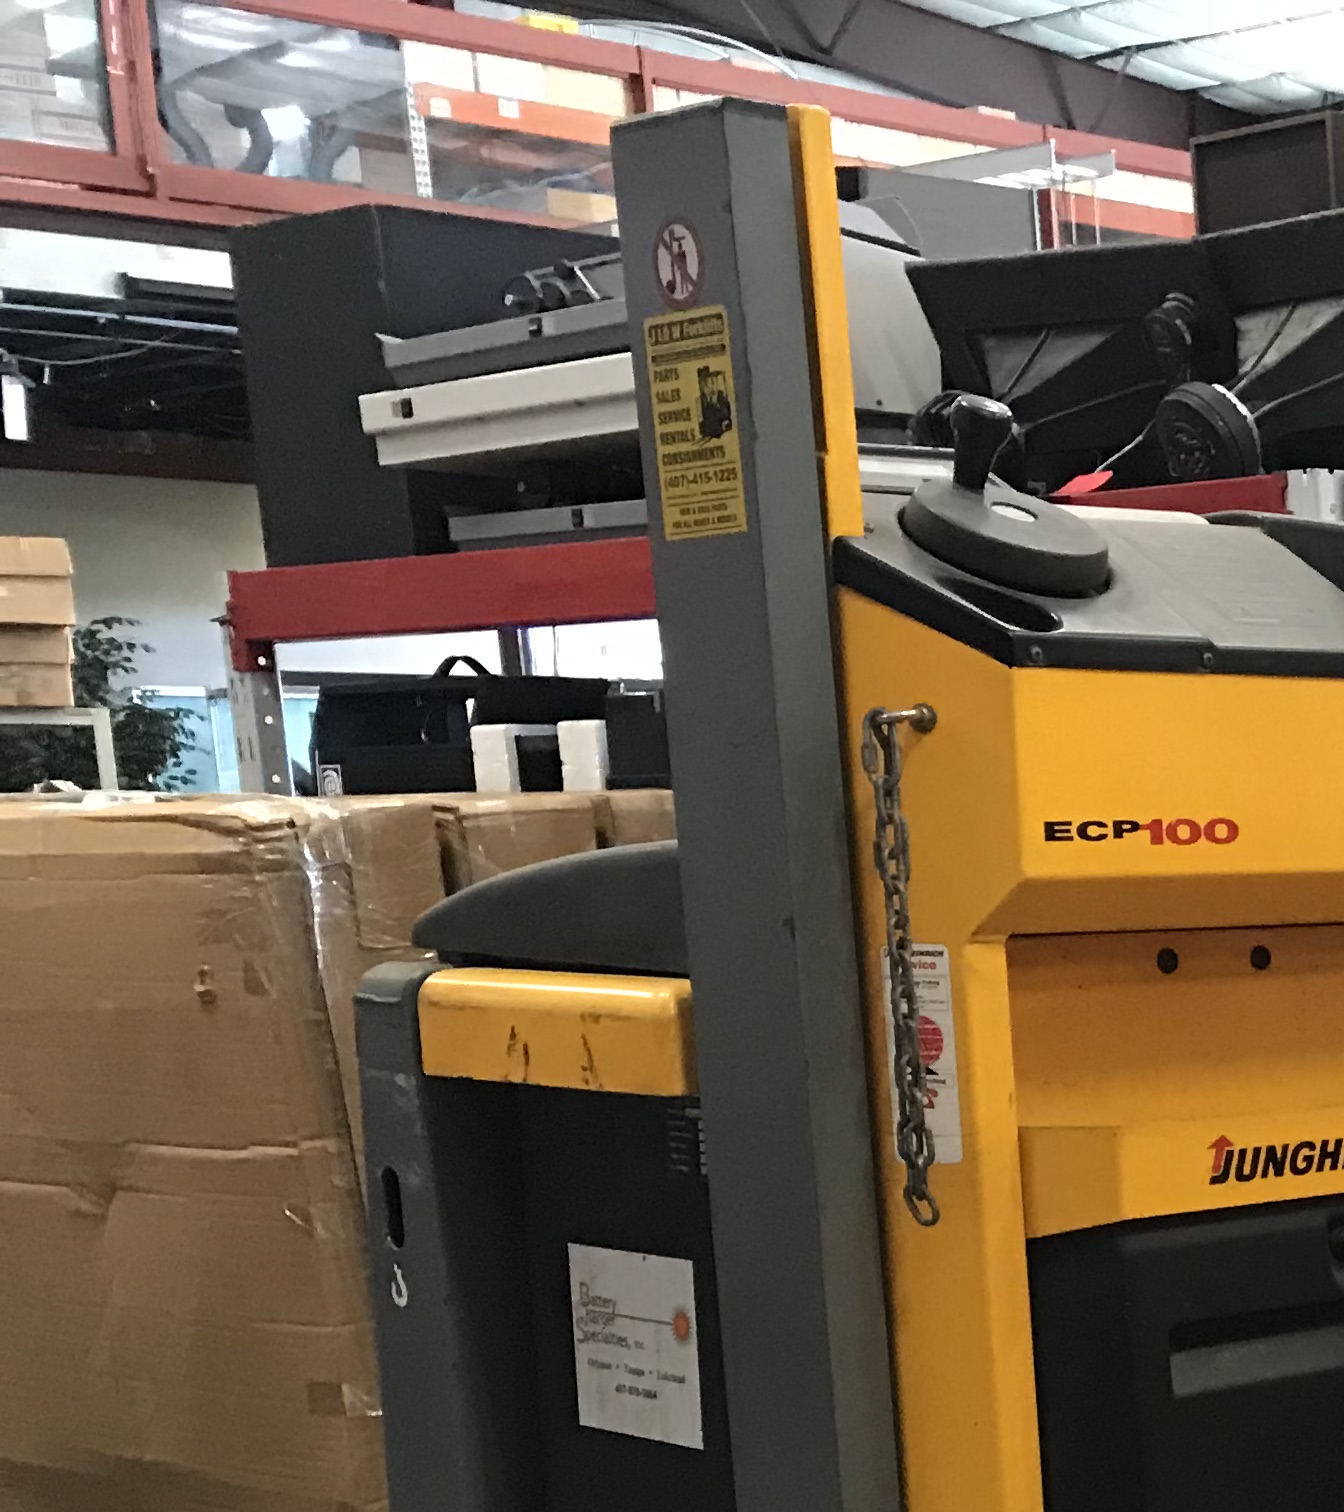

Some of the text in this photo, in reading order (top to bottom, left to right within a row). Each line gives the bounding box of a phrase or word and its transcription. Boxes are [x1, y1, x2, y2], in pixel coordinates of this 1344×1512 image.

[653, 368, 680, 383] PARTS
[656, 388, 681, 403] SALES
[658, 407, 691, 425] SERVICE
[660, 428, 695, 445] RENTALS
[662, 445, 726, 466] CONSIGNMENTS
[1044, 818, 1239, 845] ECP100
